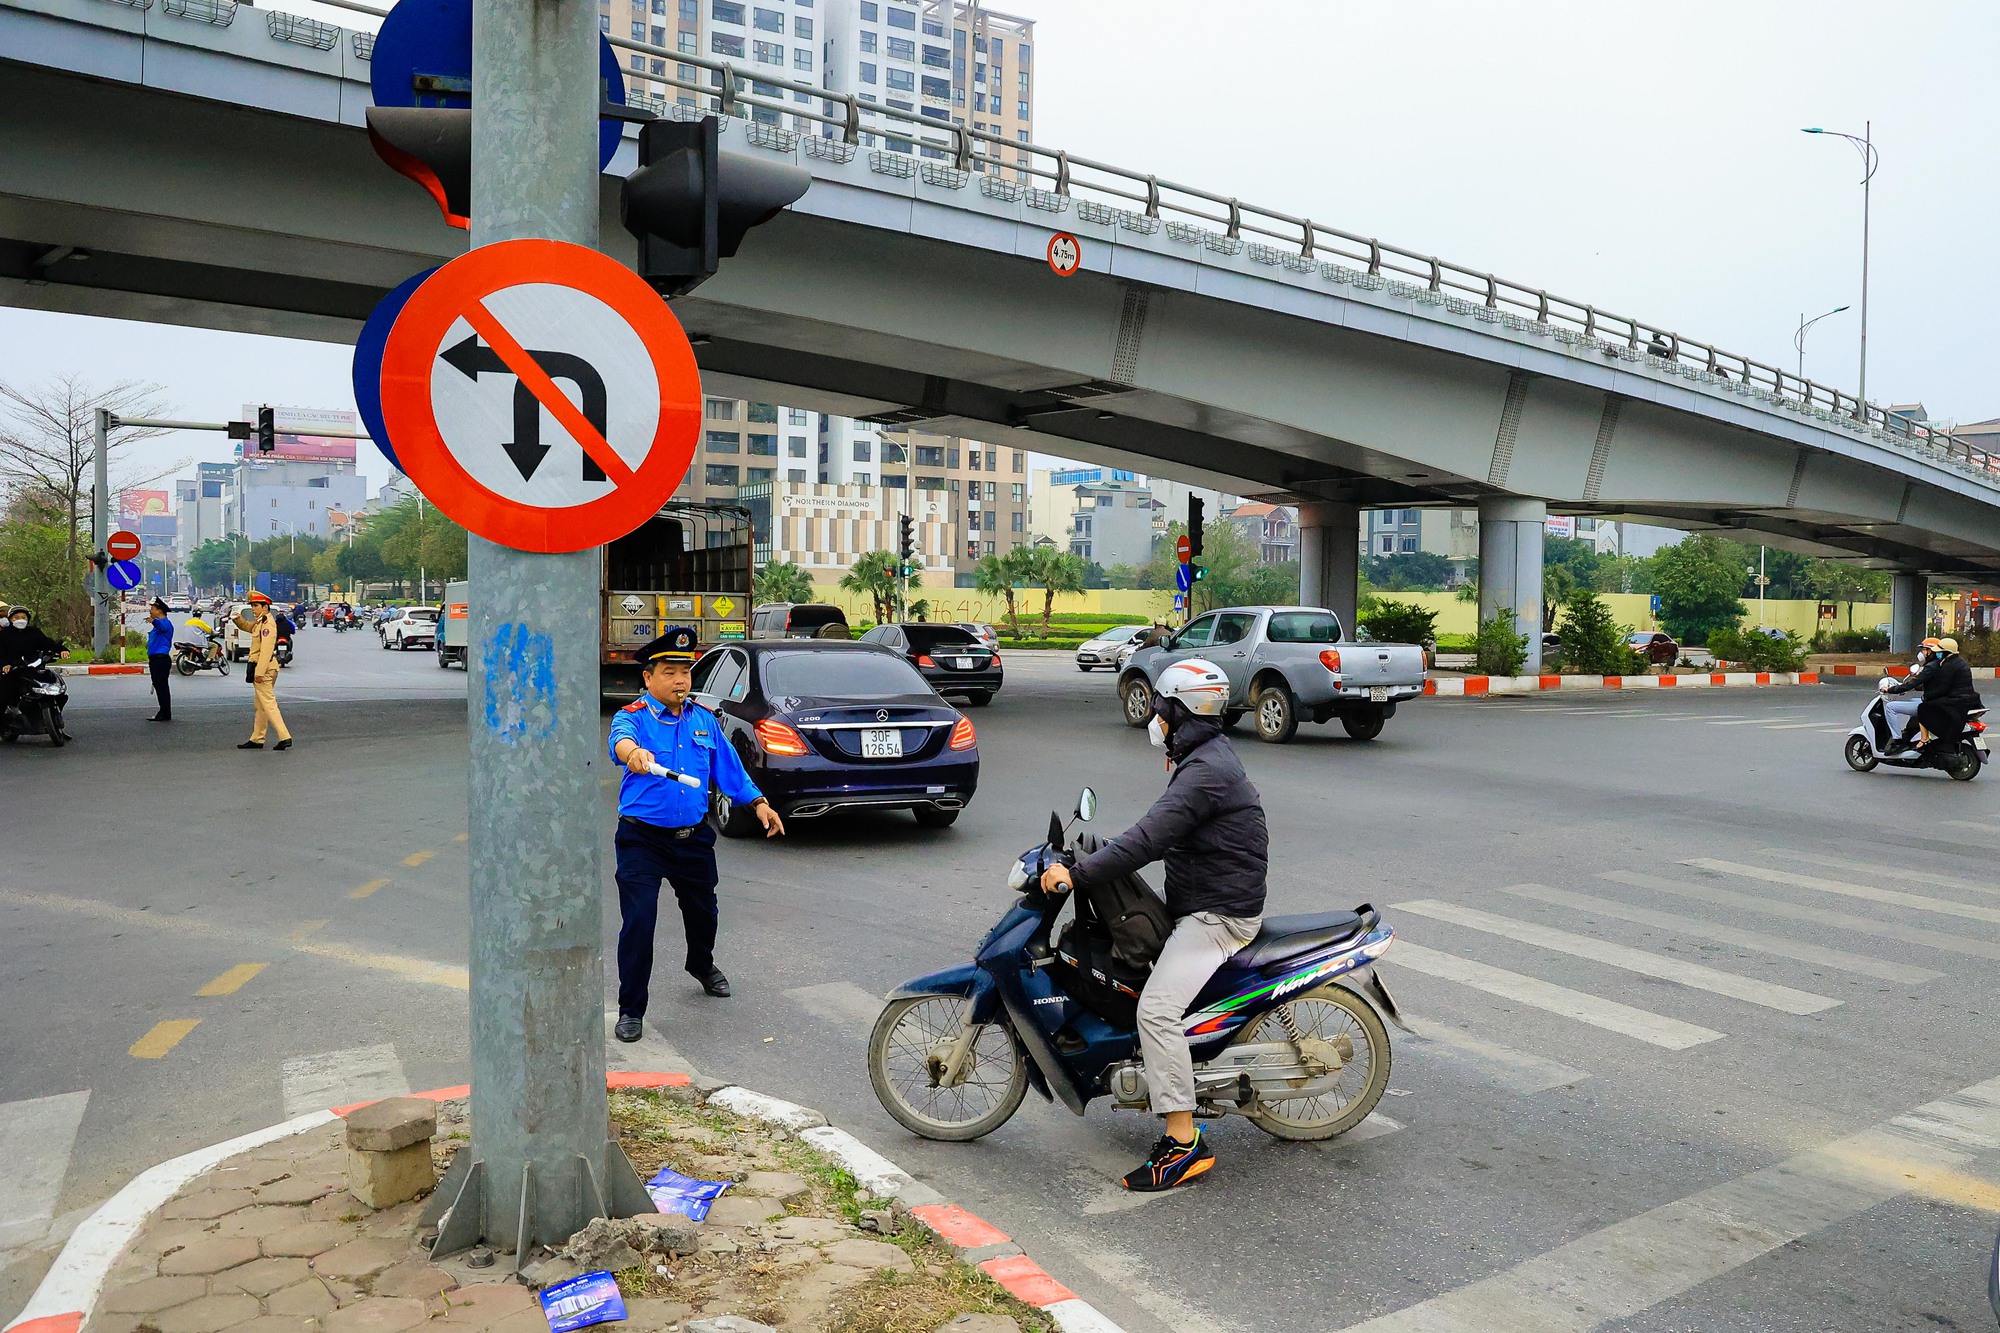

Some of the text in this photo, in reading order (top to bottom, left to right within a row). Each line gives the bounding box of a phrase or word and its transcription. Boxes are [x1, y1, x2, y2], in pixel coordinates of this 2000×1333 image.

[1054, 245, 1075, 261] 4.75m
[795, 498, 870, 508] NORTHERN DIAMOND
[633, 624, 651, 635] 29C
[870, 730, 891, 742] 30F
[865, 743, 901, 756] 126.54
[1033, 995, 1070, 1005] HONDA
